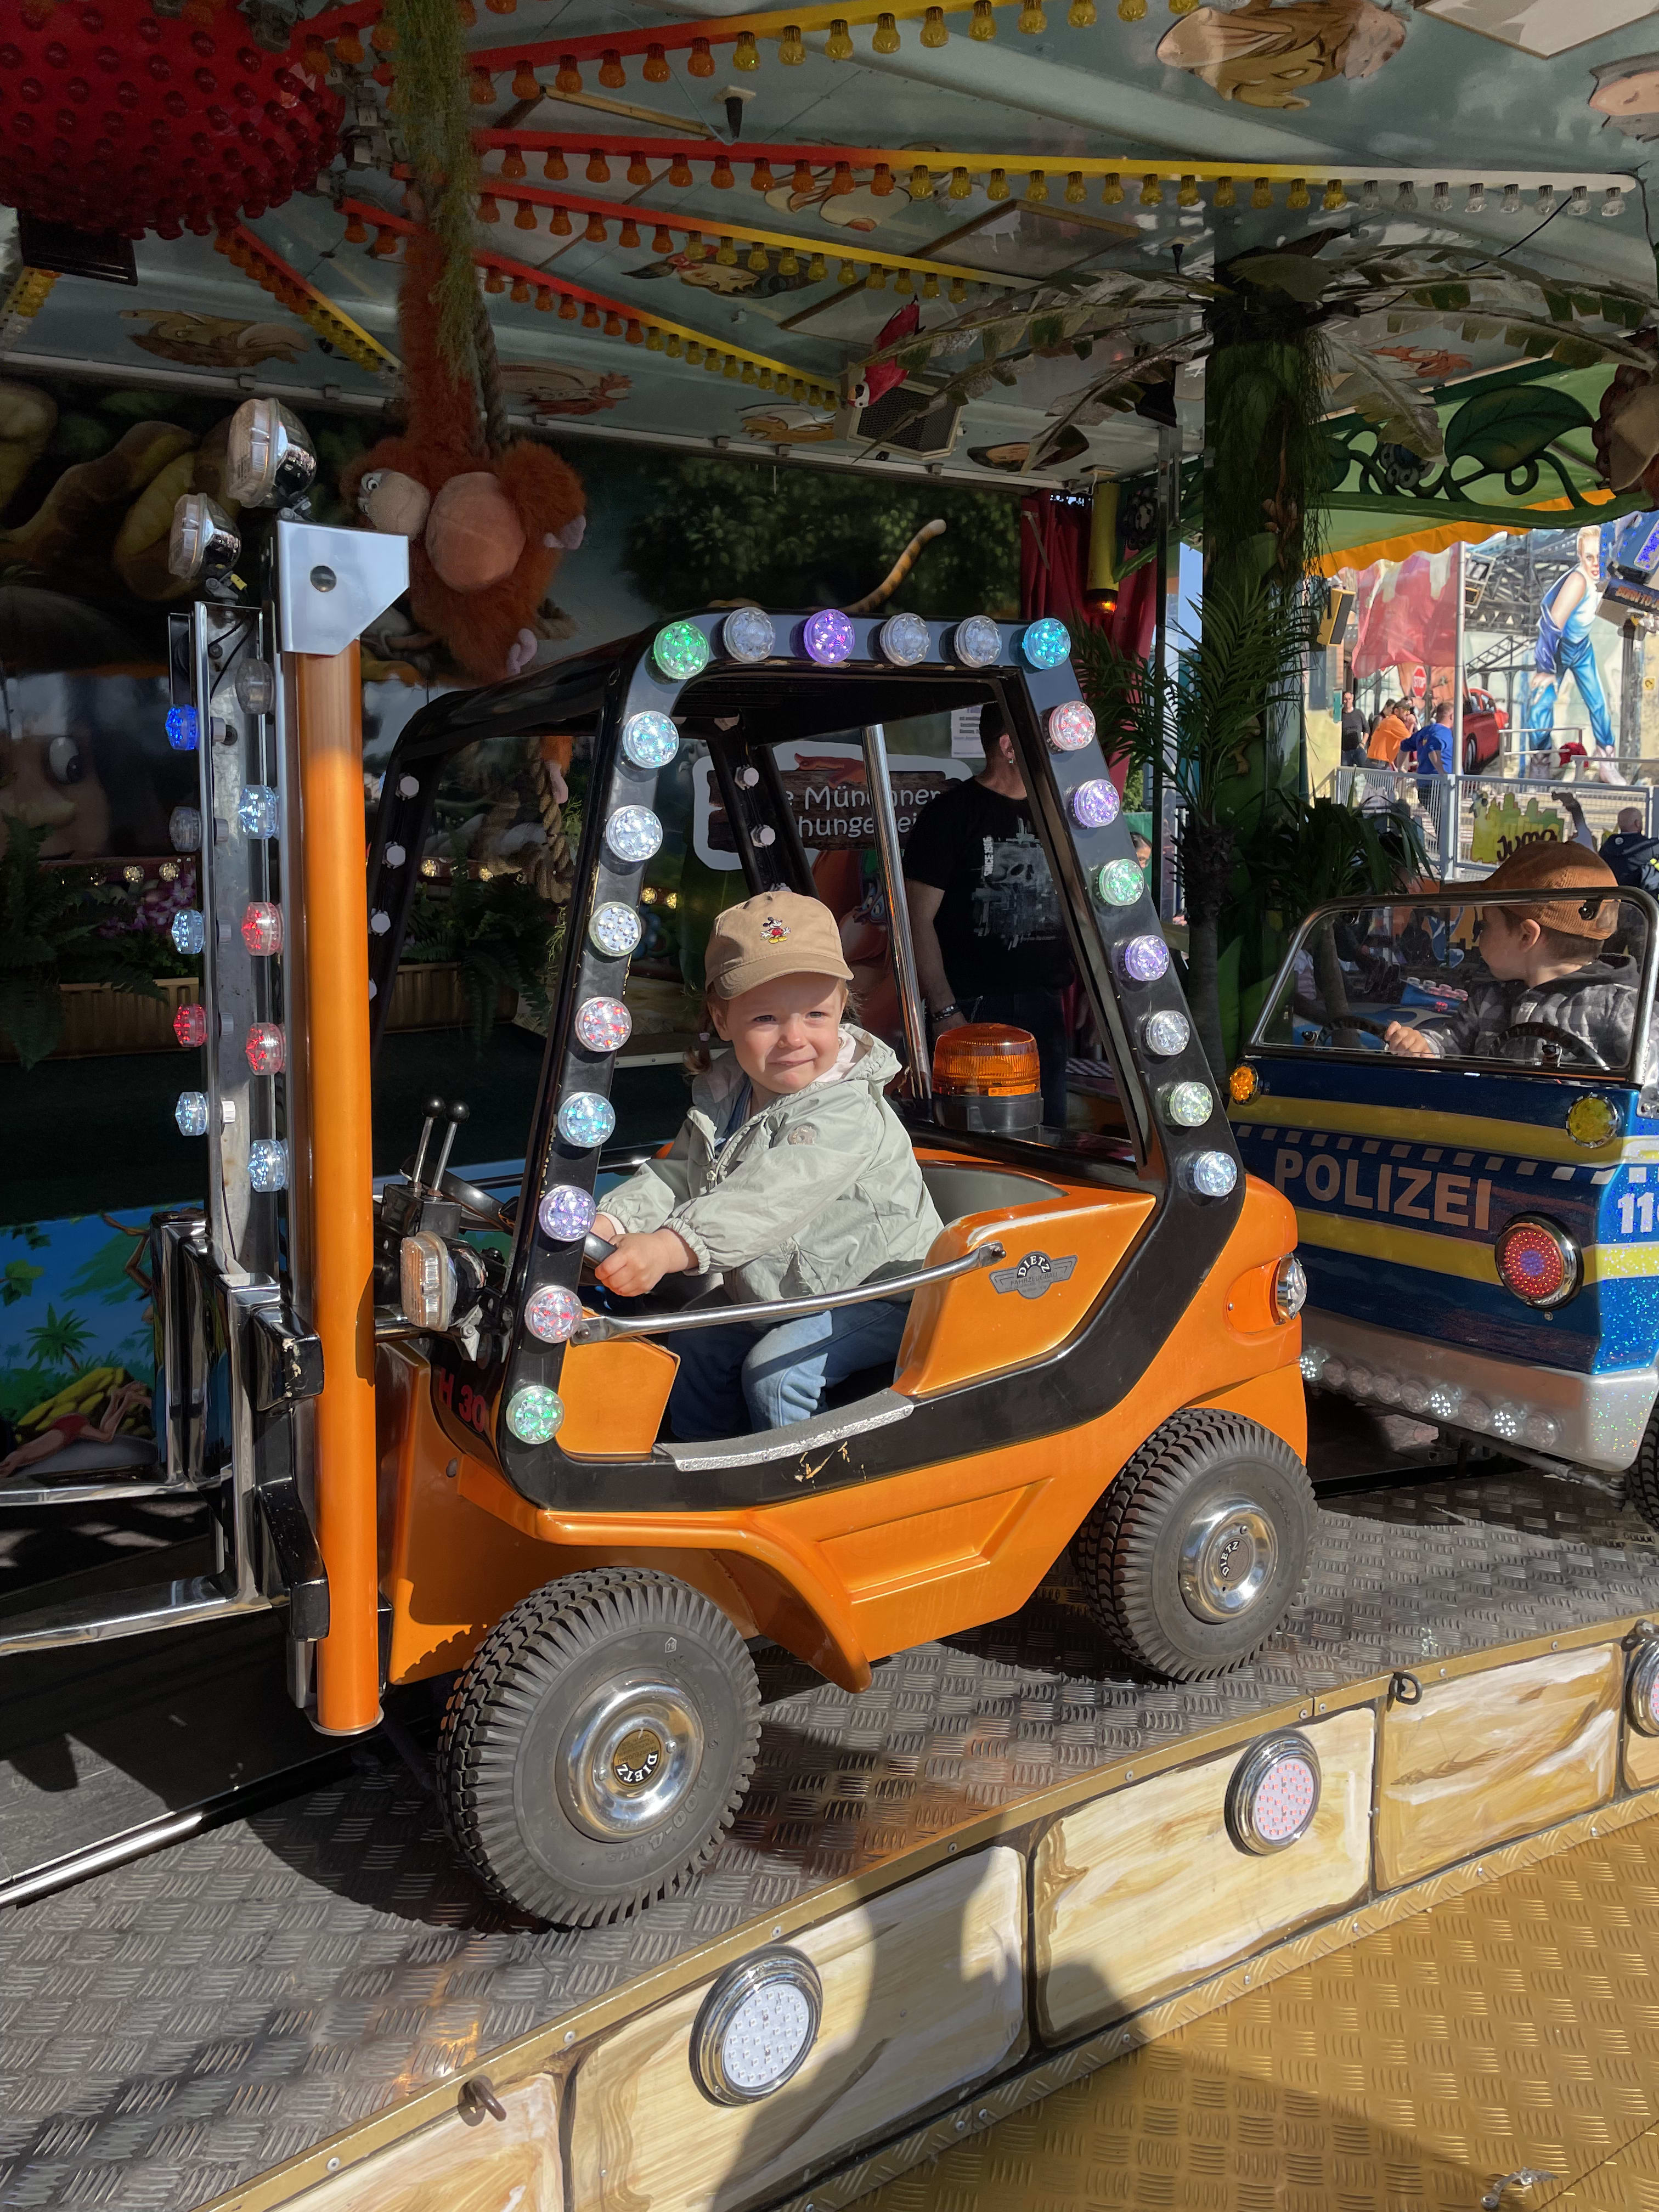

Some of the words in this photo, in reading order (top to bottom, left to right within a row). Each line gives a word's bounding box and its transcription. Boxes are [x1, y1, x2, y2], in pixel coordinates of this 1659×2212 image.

[805, 786, 940, 810] Münner
[984, 854, 994, 877] SINCE
[1274, 1148, 1492, 1231] POLIZEI
[1617, 1192, 1659, 1234] 11
[1011, 1272, 1058, 1286] FAHRZEUGBAU
[1018, 1255, 1050, 1277] DIETZ
[459, 1384, 486, 1432] 30
[1220, 1541, 1238, 1576] DIETZ
[617, 1753, 658, 1782] DIETZ
